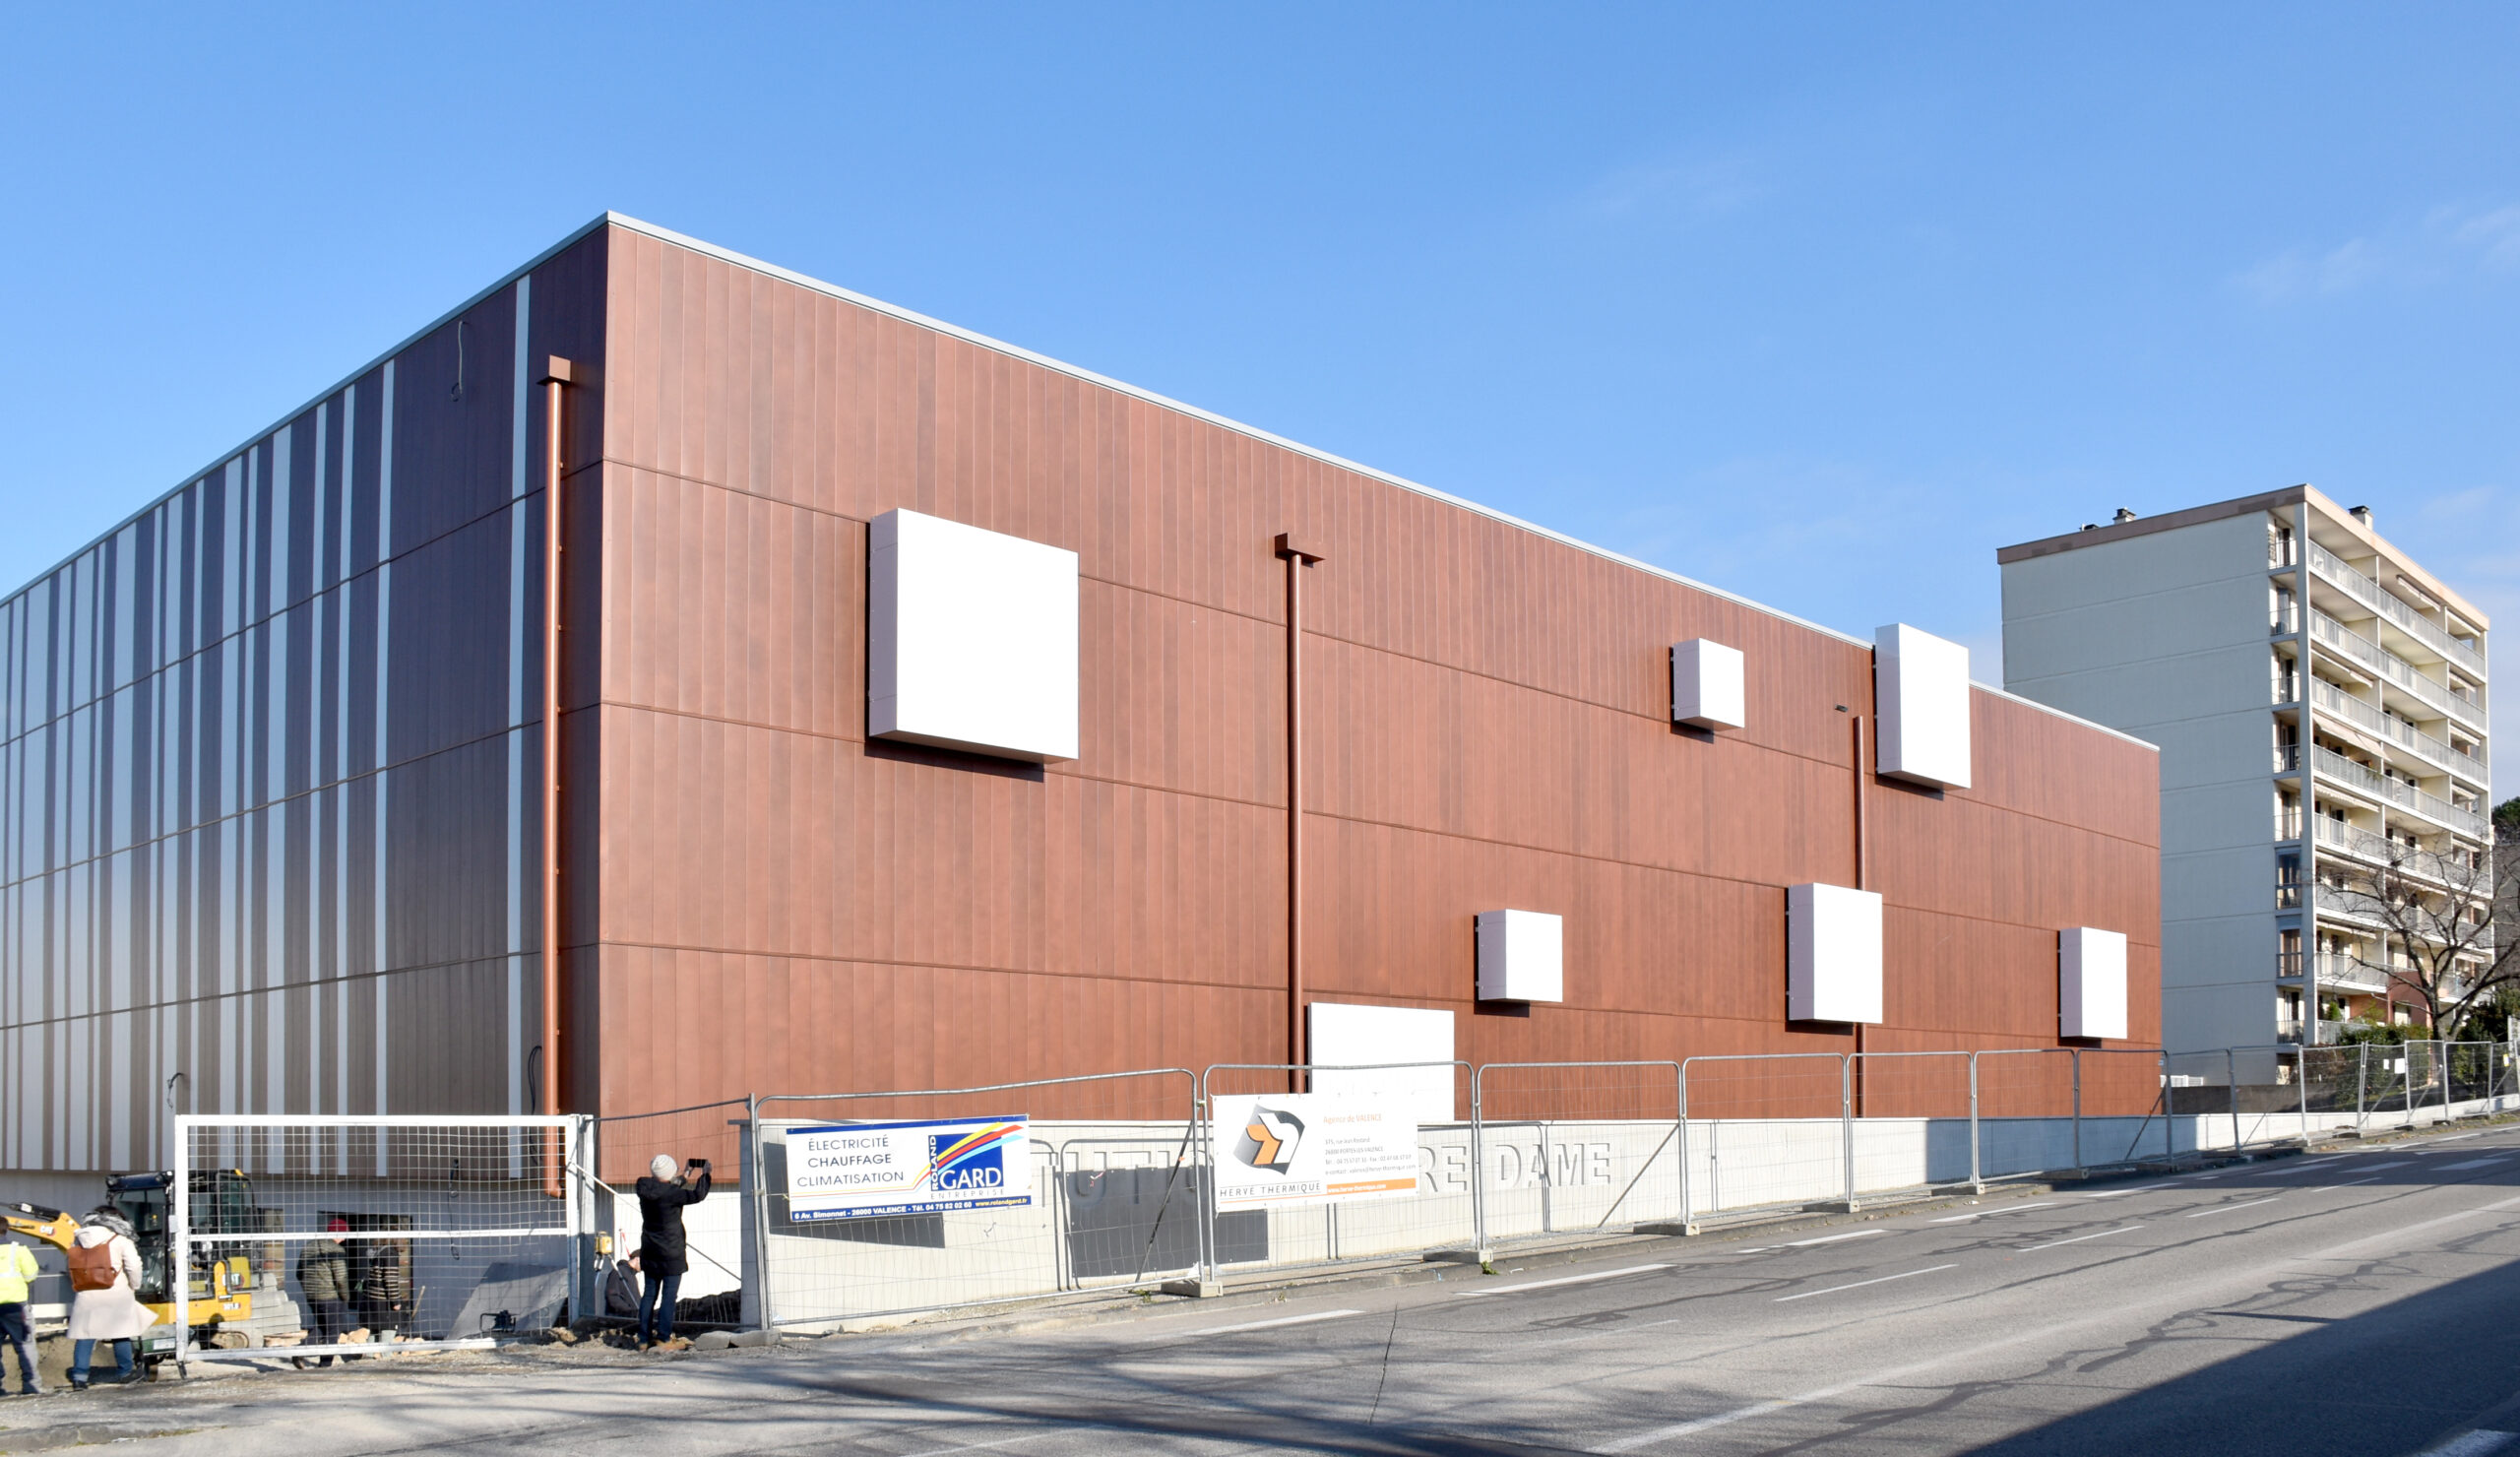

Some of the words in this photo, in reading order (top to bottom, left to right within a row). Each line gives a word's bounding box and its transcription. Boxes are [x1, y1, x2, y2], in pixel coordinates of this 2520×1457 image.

[1355, 1112, 1382, 1122] VALENCE
[808, 1134, 889, 1151] ÉLECTRICITÉ
[807, 1154, 892, 1169] CHAUFFAGE
[930, 1135, 939, 1191] ROLAND
[1492, 1141, 1630, 1188] DAME
[796, 1172, 905, 1187] CLIMATISATION
[939, 1168, 1002, 1190] GARD
[930, 1188, 1004, 1200] ENTREPRISE
[1260, 1182, 1321, 1194] THERMIQUE
[873, 1205, 907, 1214] VALENCE
